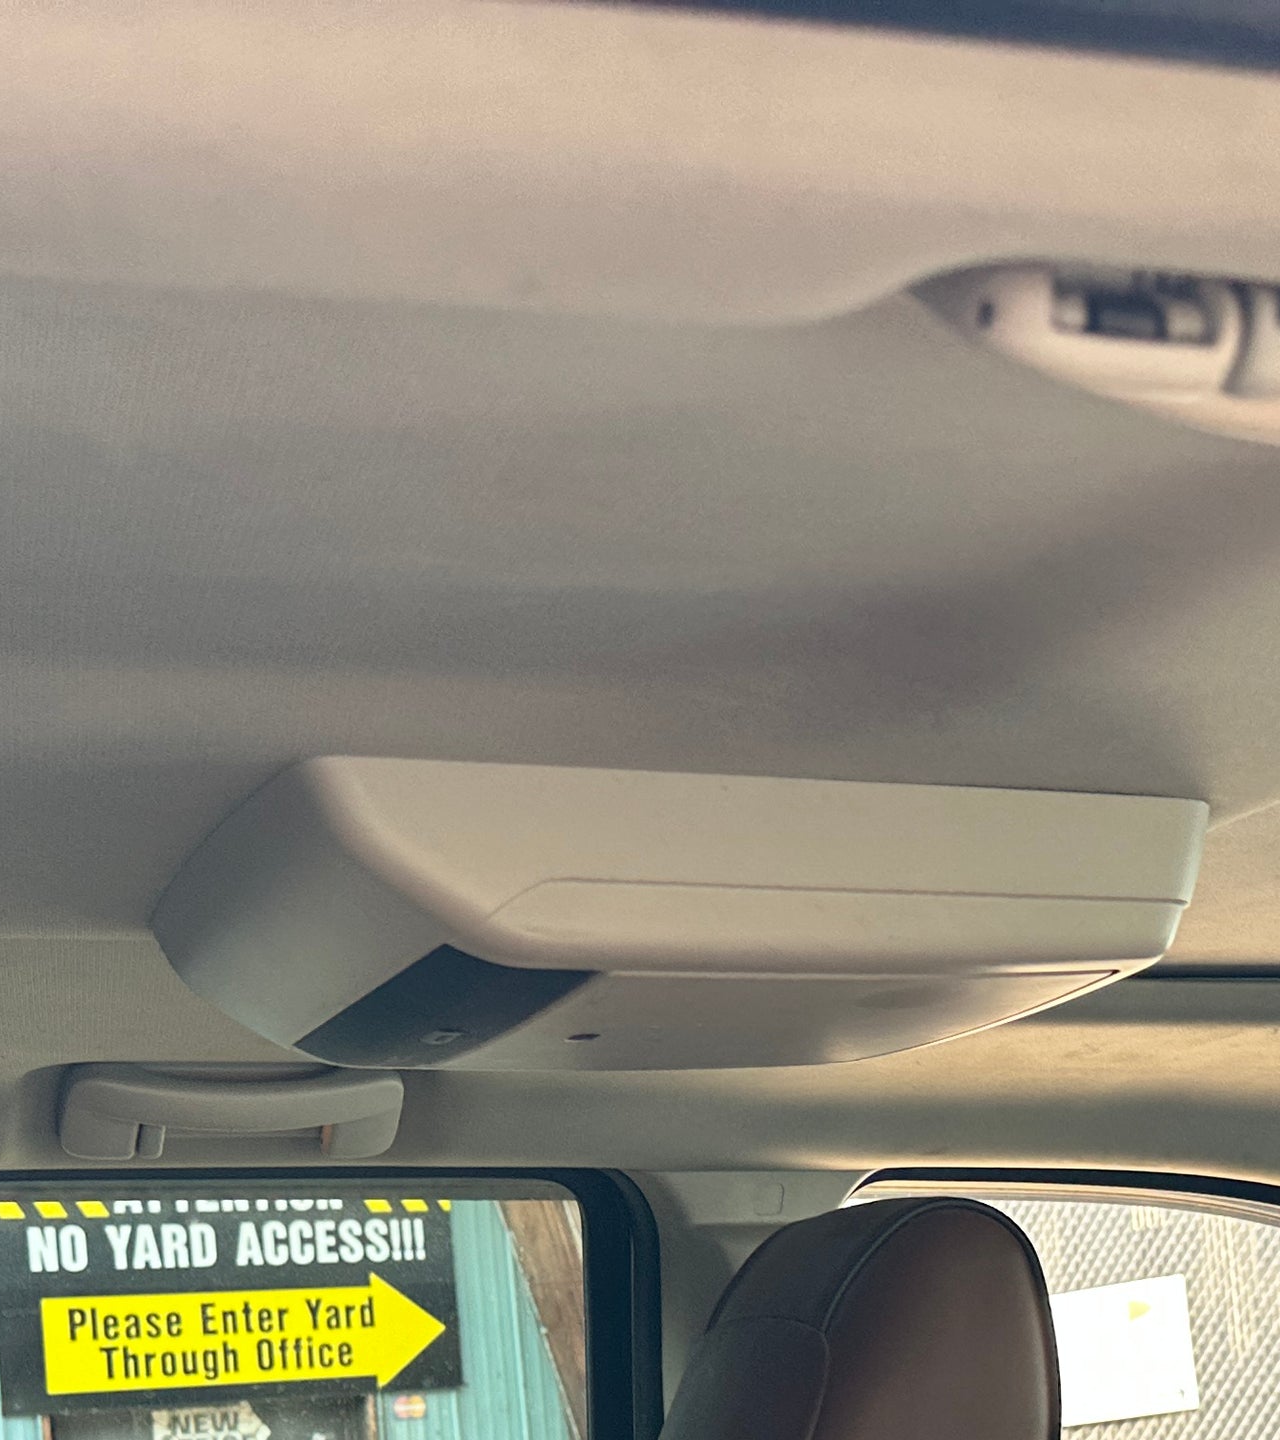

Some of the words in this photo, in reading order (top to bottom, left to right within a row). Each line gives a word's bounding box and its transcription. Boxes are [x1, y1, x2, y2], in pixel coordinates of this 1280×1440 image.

[27, 1225, 88, 1273] NO
[105, 1222, 218, 1271] YARD
[236, 1219, 426, 1267] ACCESS!!!
[68, 1306, 183, 1341] Please
[201, 1301, 288, 1335] Enter
[306, 1297, 376, 1329] Yard
[100, 1343, 240, 1380] Through
[258, 1335, 354, 1371] Office
[169, 1410, 239, 1435] NEW
